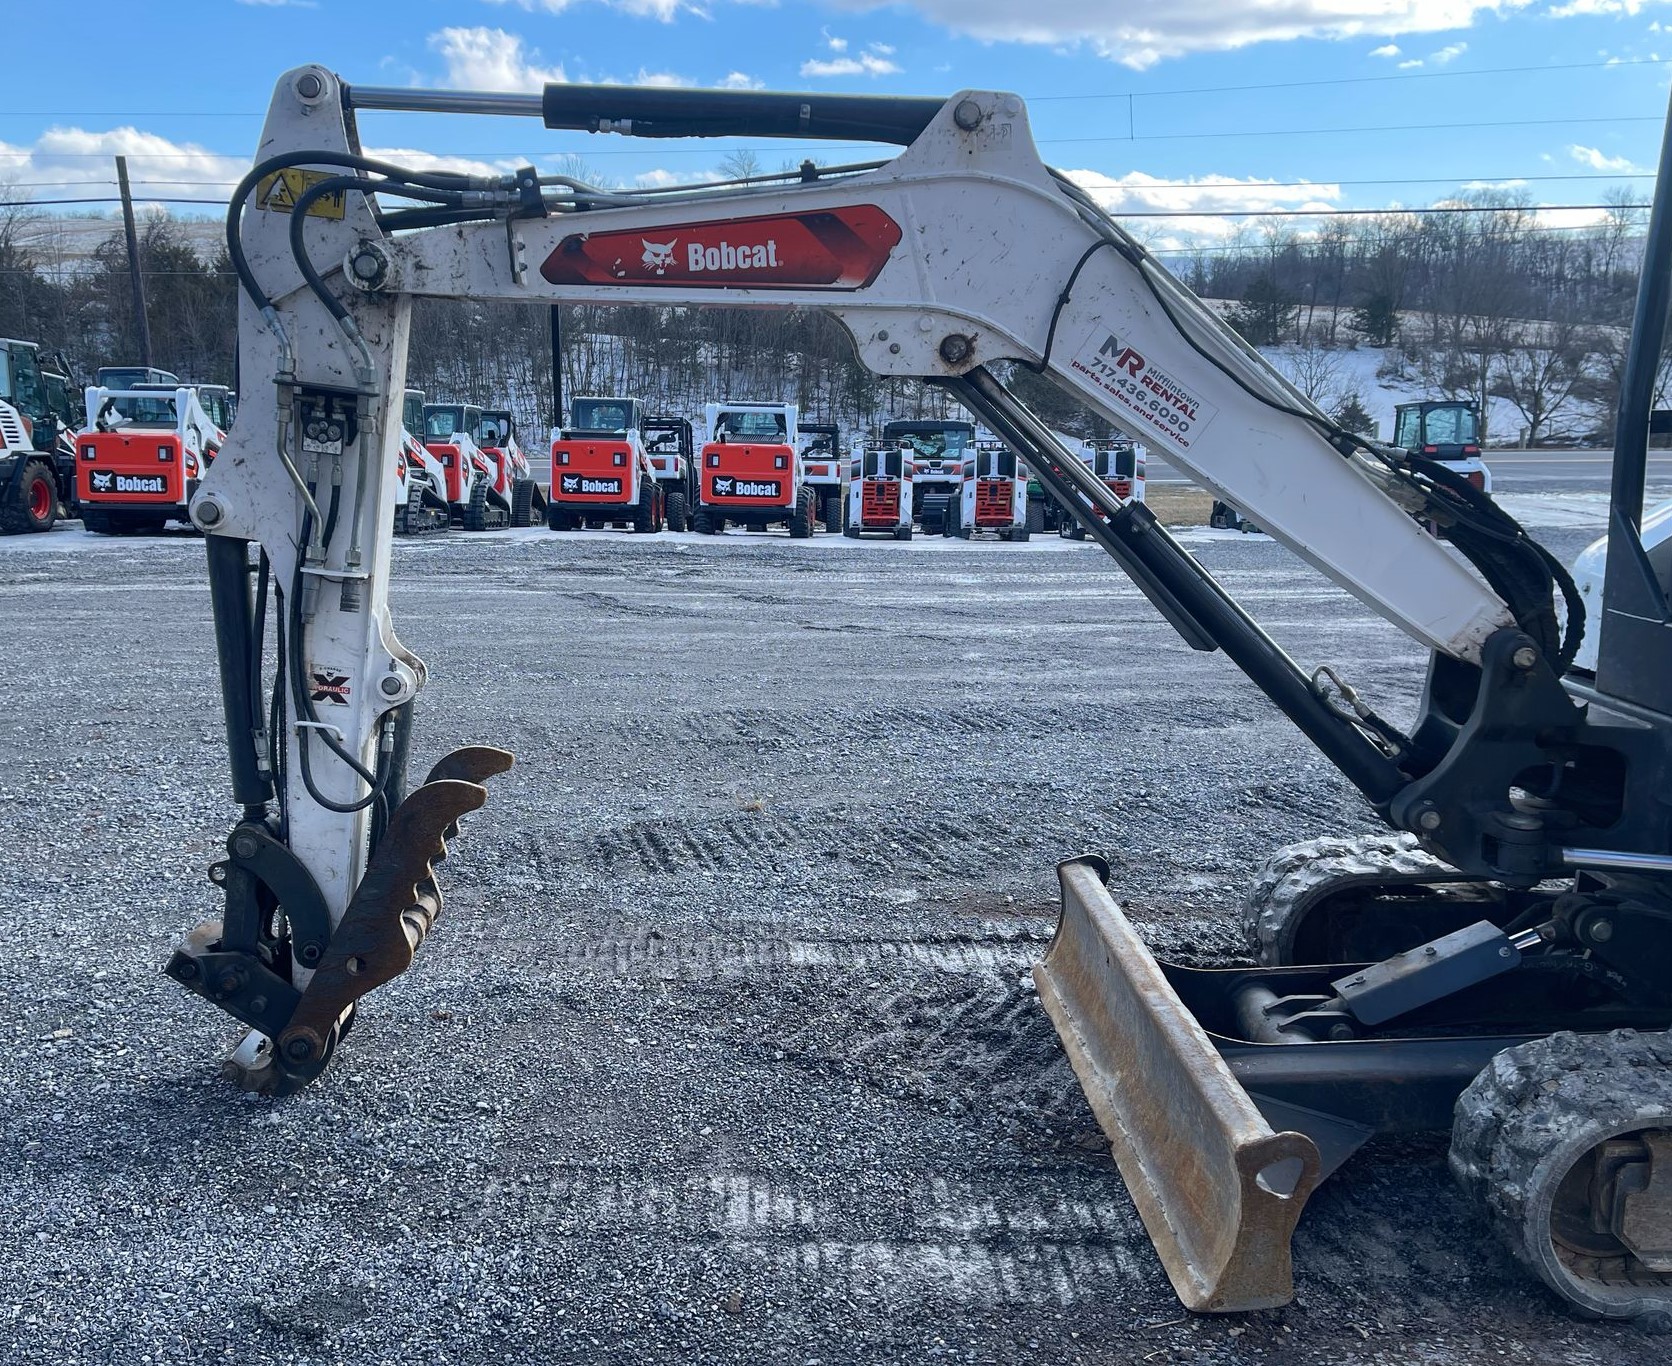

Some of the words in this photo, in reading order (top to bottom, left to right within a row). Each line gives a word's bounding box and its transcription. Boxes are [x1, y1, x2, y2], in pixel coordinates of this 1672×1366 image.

[687, 240, 777, 272] Bobcat
[1071, 360, 1102, 386] parts,
[1103, 381, 1132, 407] sales,
[1132, 404, 1155, 421] and
[1153, 419, 1190, 448] service
[1090, 356, 1190, 433] 717.436.6090
[1140, 374, 1197, 421] RENTAL
[1146, 367, 1200, 409] Mifflintown
[116, 476, 163, 492] Bobcat
[581, 480, 619, 493] Bobcat
[735, 482, 777, 496] Bobcat
